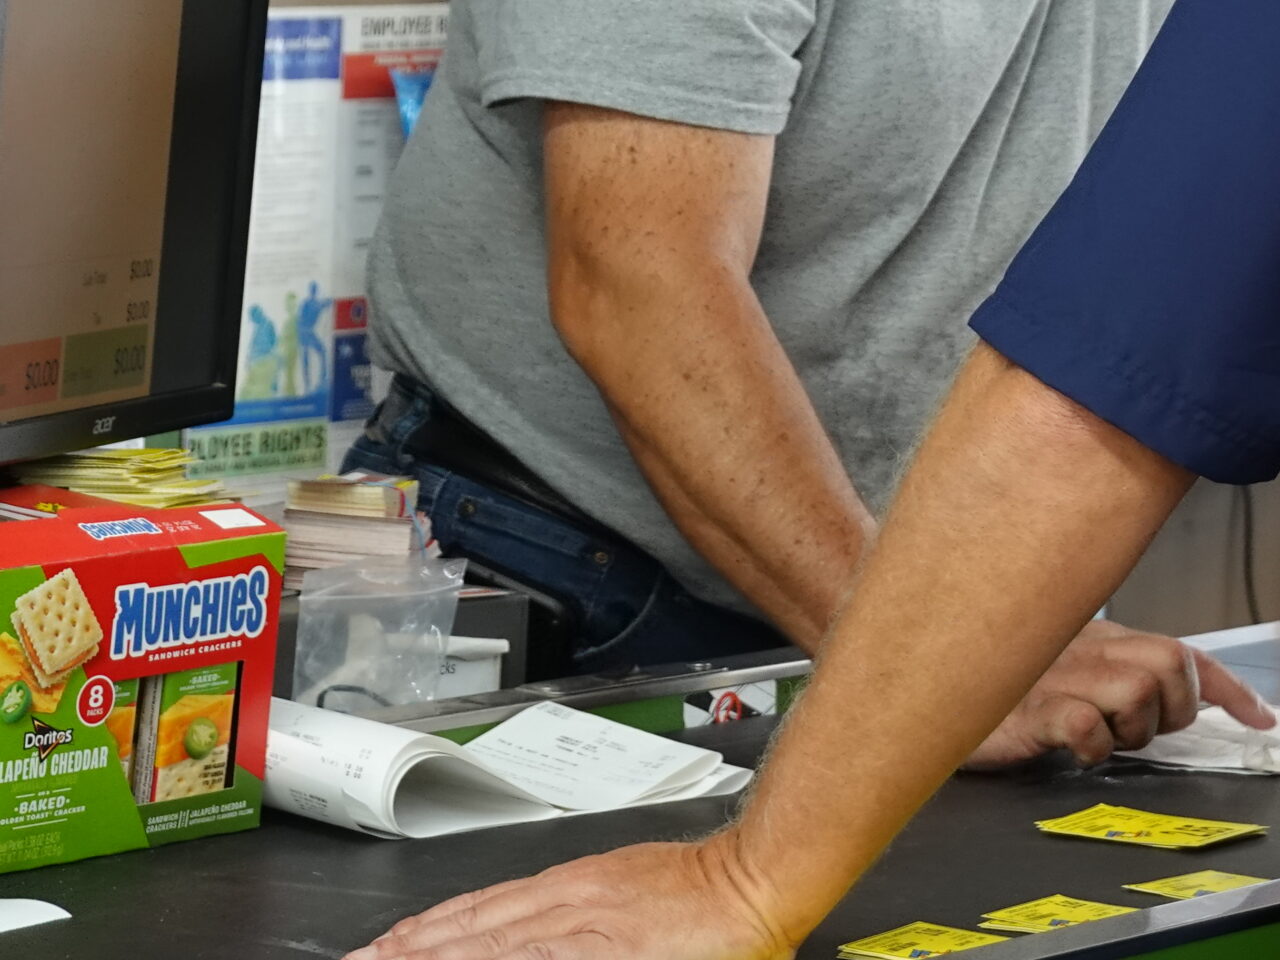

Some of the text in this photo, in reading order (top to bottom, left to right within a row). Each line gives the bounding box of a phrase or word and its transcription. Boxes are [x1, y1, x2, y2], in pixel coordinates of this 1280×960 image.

[114, 345, 146, 375] $0.00
[25, 359, 59, 390] $0.00
[93, 416, 116, 434] acer
[189, 432, 254, 460] PLOYEE
[110, 566, 268, 660] MUNCHIES
[149, 640, 242, 661] SANDWICH CRACKERS
[440, 661, 456, 675] cks
[89, 685, 104, 708] 8
[87, 708, 103, 716] PACKS
[24, 729, 73, 750] Doritos
[50, 746, 109, 776] CHEDDAR
[19, 795, 66, 814] BAKED
[147, 813, 179, 826] SANDWICH
[189, 804, 220, 818] JALAPEÑO
[220, 800, 247, 813] CHEDDAR
[0, 815, 25, 826] OLDEN
[54, 805, 86, 817] CRACKER
[146, 821, 178, 833] CRACKERS
